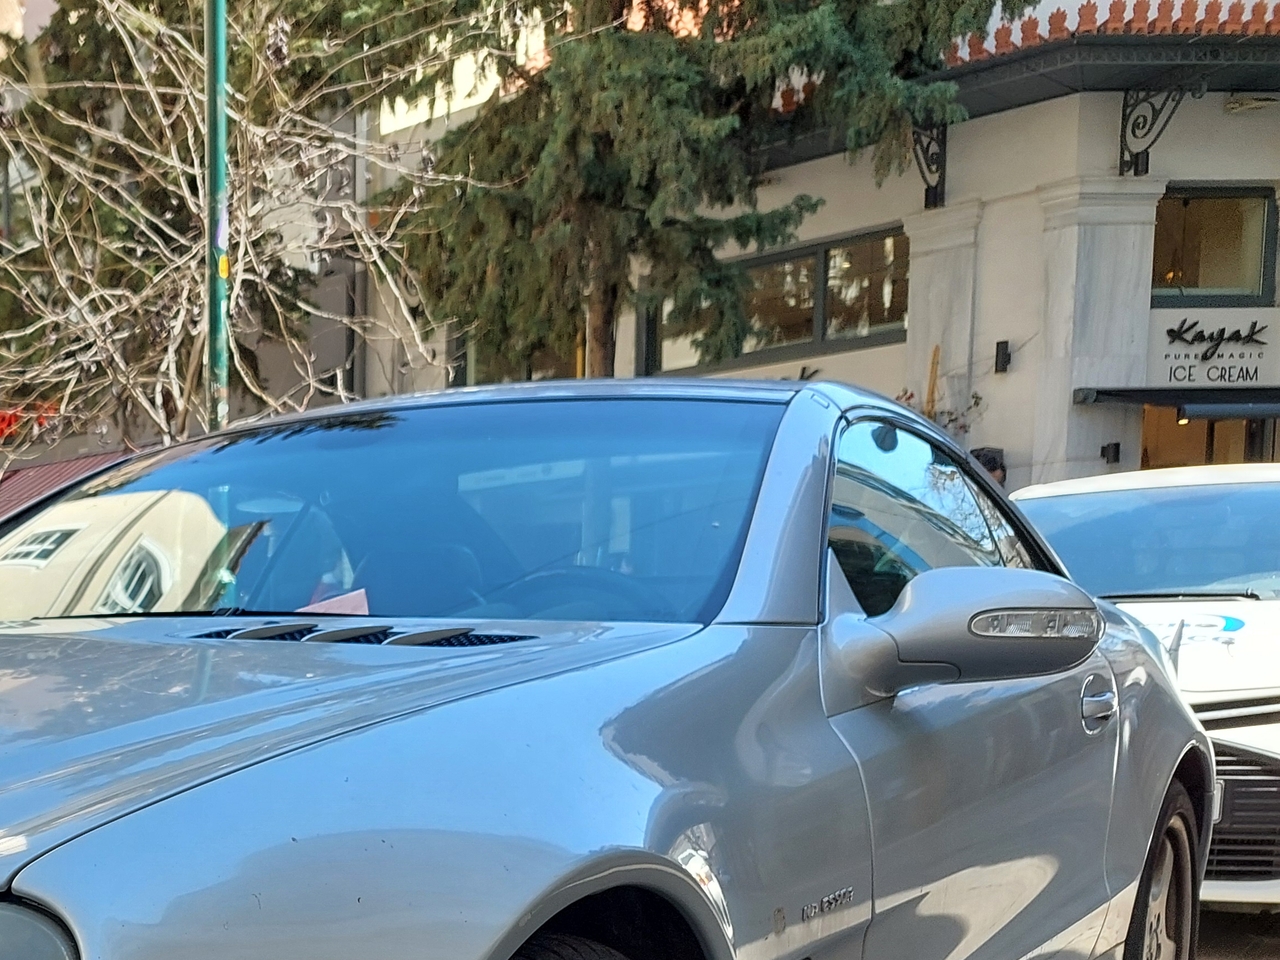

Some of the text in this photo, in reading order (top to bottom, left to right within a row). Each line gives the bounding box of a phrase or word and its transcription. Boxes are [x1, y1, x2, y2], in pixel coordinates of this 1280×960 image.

[1166, 318, 1268, 361] Kayak
[1217, 352, 1264, 360] MAGIC
[1169, 366, 1258, 383] ICE CREAM
